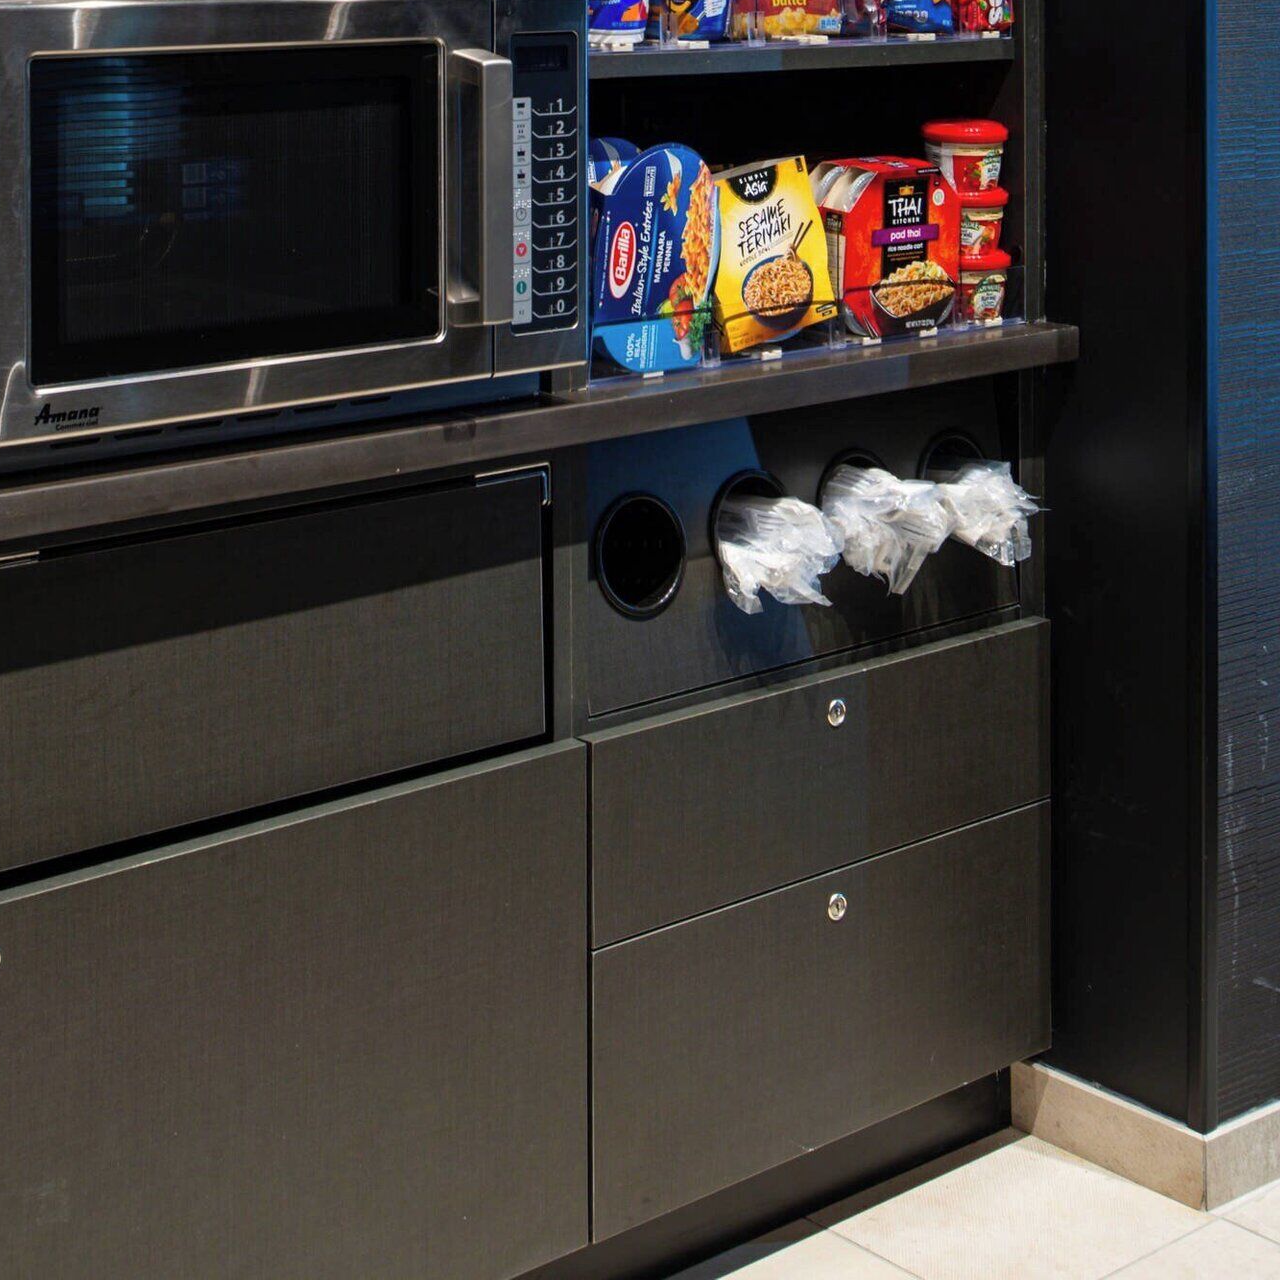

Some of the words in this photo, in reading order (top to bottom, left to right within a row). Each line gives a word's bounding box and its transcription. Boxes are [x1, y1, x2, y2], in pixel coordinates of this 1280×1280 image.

[556, 98, 565, 111] 1
[556, 121, 565, 134] 2
[556, 143, 565, 156] 3
[556, 165, 565, 178] 4
[739, 171, 768, 185] SIMPLY
[556, 188, 565, 201] 5
[743, 180, 768, 197] Asia
[888, 197, 923, 218] THAI
[556, 210, 565, 223] 6
[738, 198, 786, 239] SESAME
[892, 216, 920, 225] KITCHEN
[556, 233, 565, 246] 7
[737, 213, 792, 258] TERIYAKI
[890, 230, 906, 243] pad
[907, 228, 922, 238] thai
[556, 255, 565, 268] 8
[614, 227, 631, 282] Barilla
[631, 243, 650, 315] Italian-Style
[643, 200, 655, 243] Entrées
[653, 230, 666, 284] MARINARA
[663, 239, 673, 273] PENNE
[556, 277, 565, 290] 9
[556, 299, 565, 312] 0
[626, 332, 635, 363] 100%
[34, 403, 100, 426] Amana
